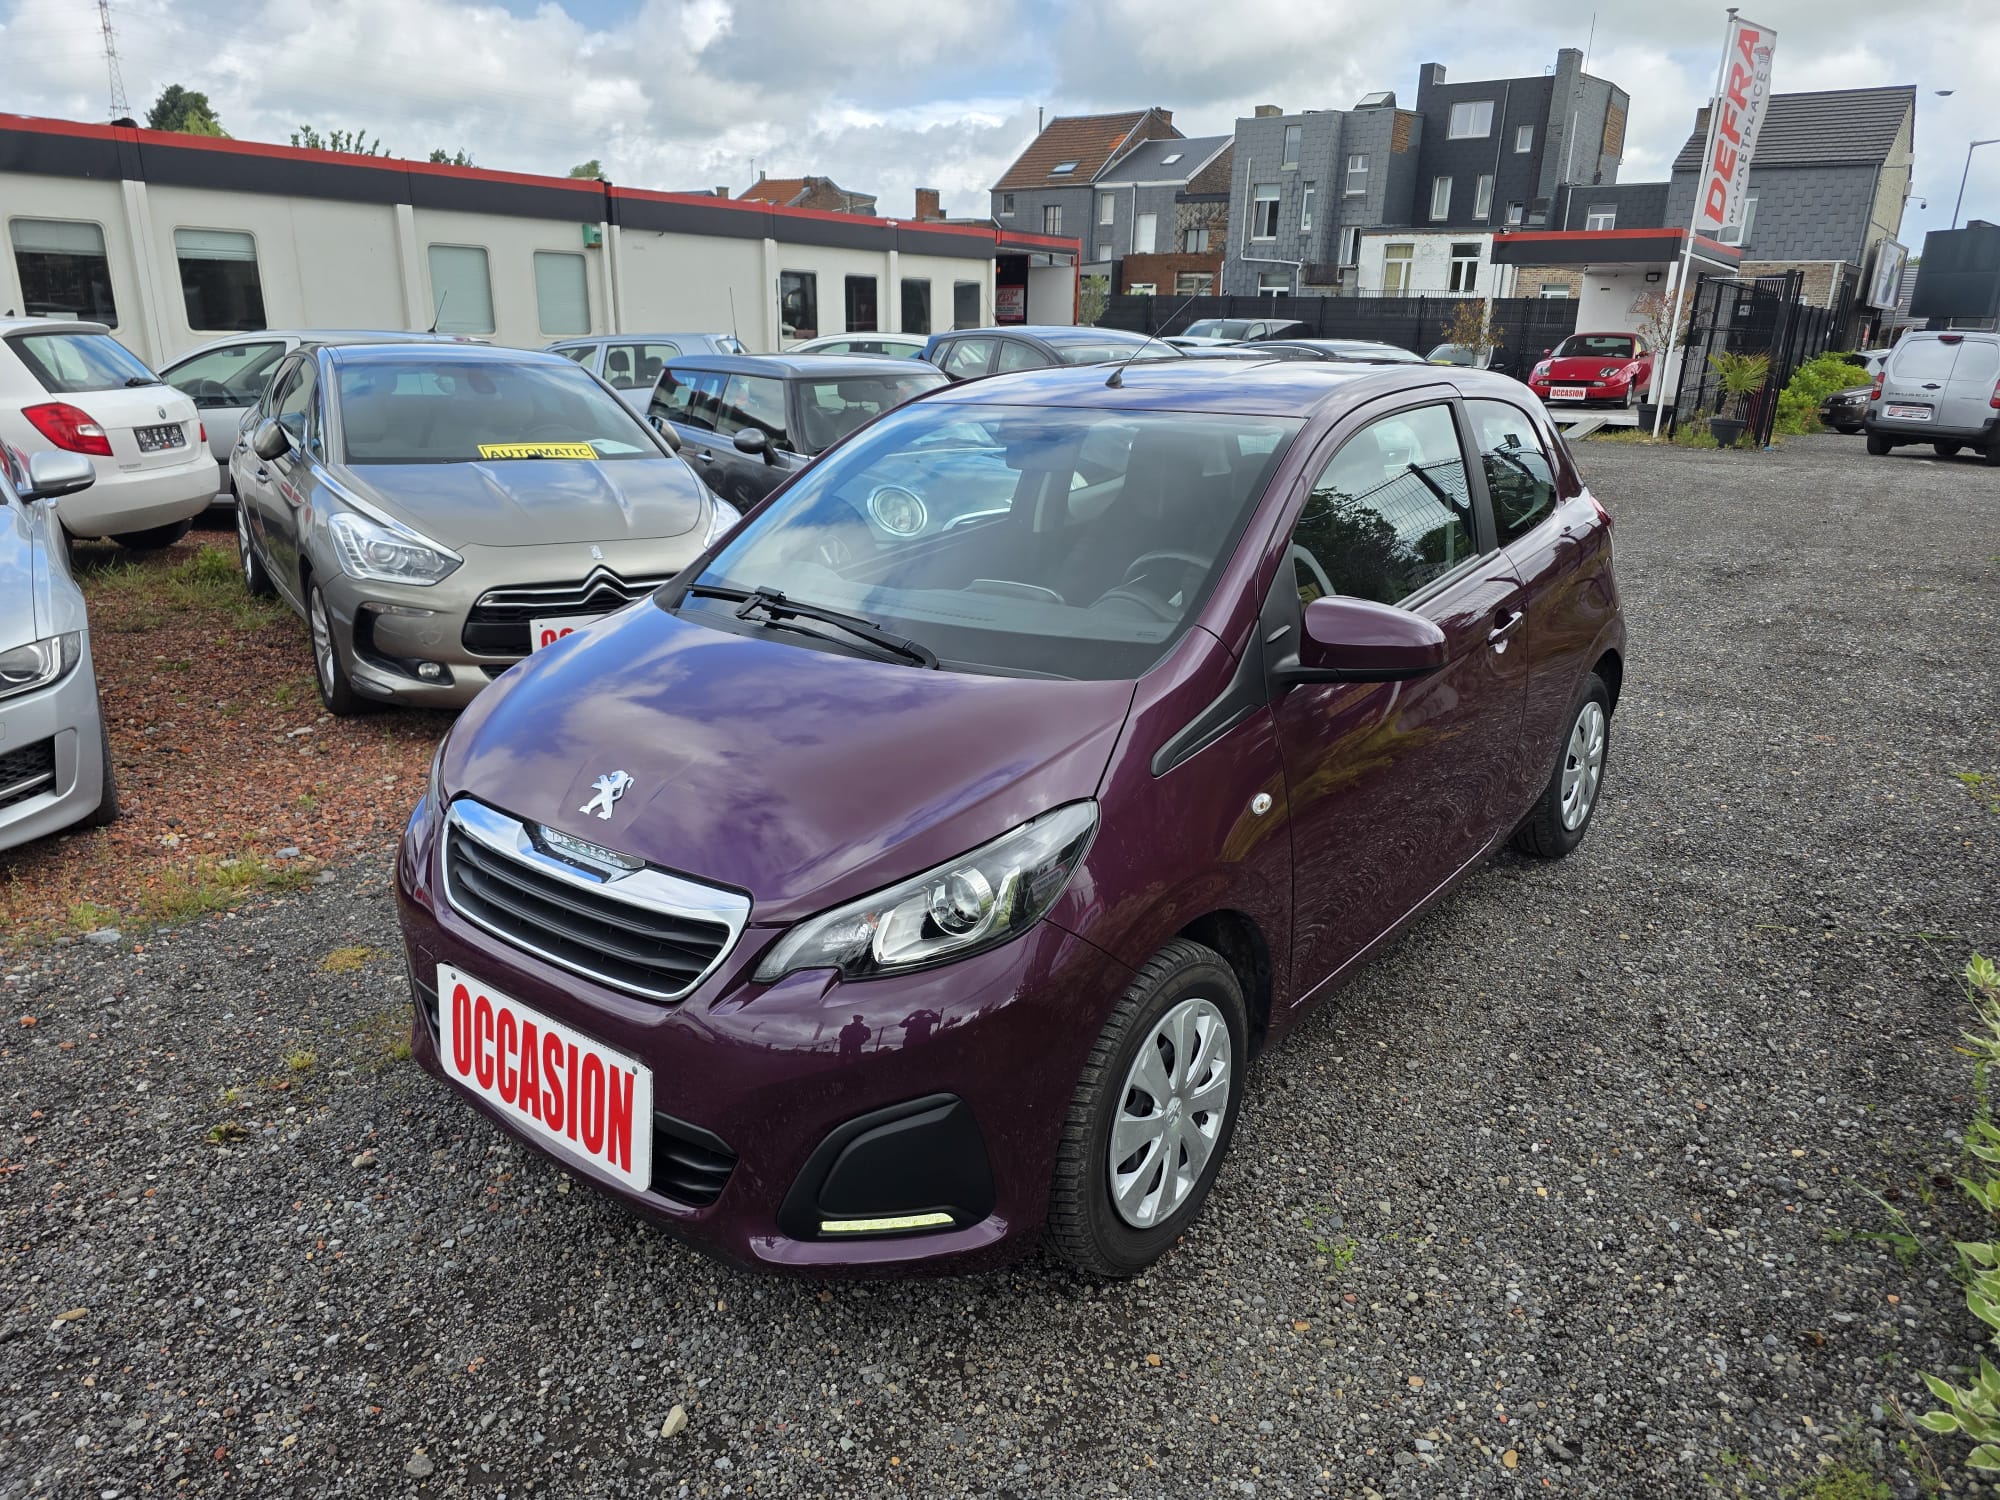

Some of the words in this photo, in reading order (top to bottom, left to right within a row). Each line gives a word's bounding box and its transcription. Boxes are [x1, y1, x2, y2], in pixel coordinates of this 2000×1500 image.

[1704, 28, 1760, 225] DEFRA
[1551, 389, 1584, 398] OCCASION
[490, 447, 592, 459] AUTOMATIC
[452, 983, 635, 1174] OCCASION
